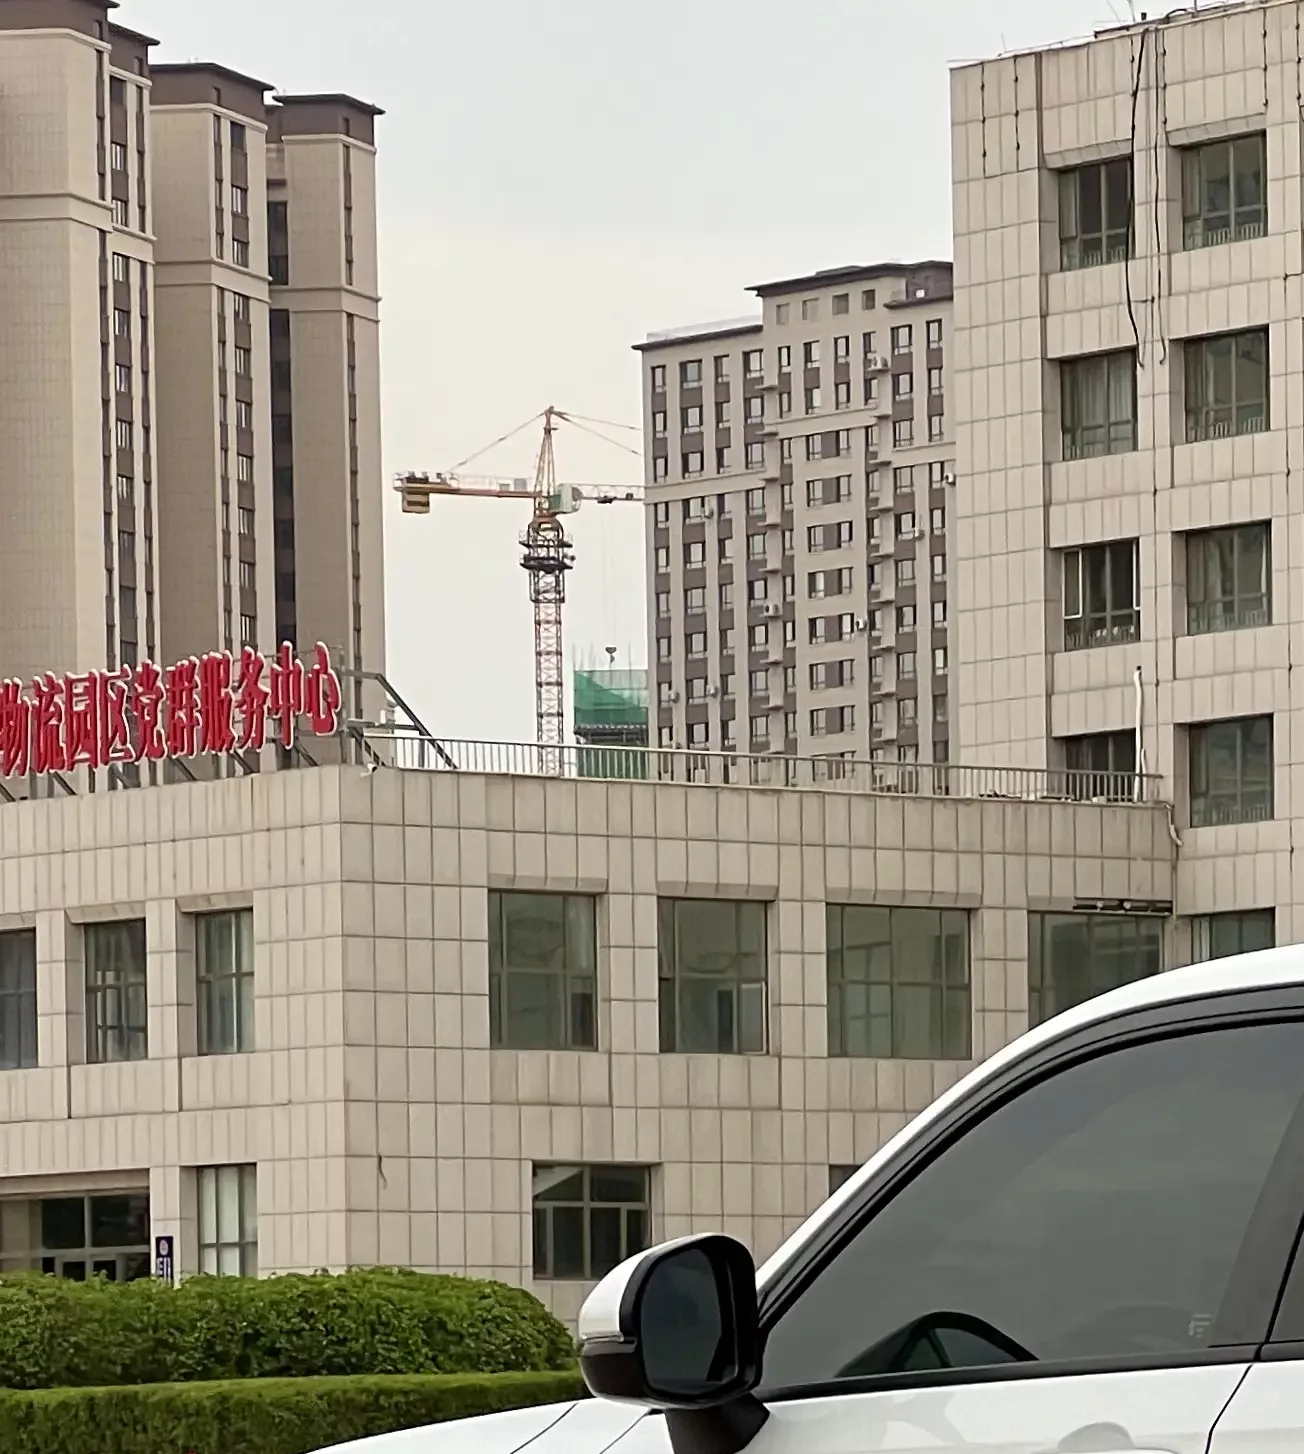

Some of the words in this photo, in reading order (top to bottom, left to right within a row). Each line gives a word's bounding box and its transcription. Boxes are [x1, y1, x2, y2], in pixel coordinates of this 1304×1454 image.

[0, 640, 342, 778] 物流园区党群服务中心
